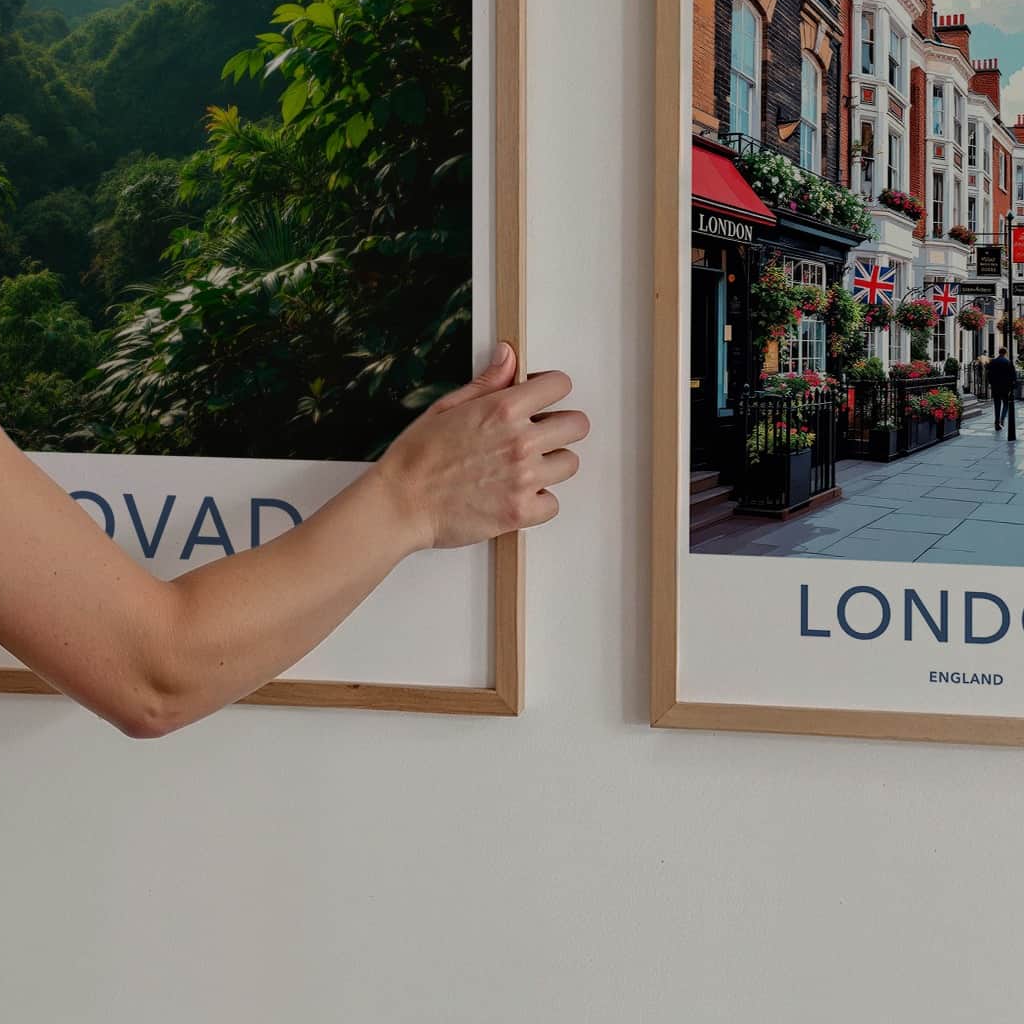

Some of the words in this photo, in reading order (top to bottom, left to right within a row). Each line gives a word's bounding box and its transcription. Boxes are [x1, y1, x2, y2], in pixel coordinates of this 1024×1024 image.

[698, 213, 753, 242] LONDON
[800, 584, 1024, 644] LOND
[929, 671, 1004, 686] ENGLAND
